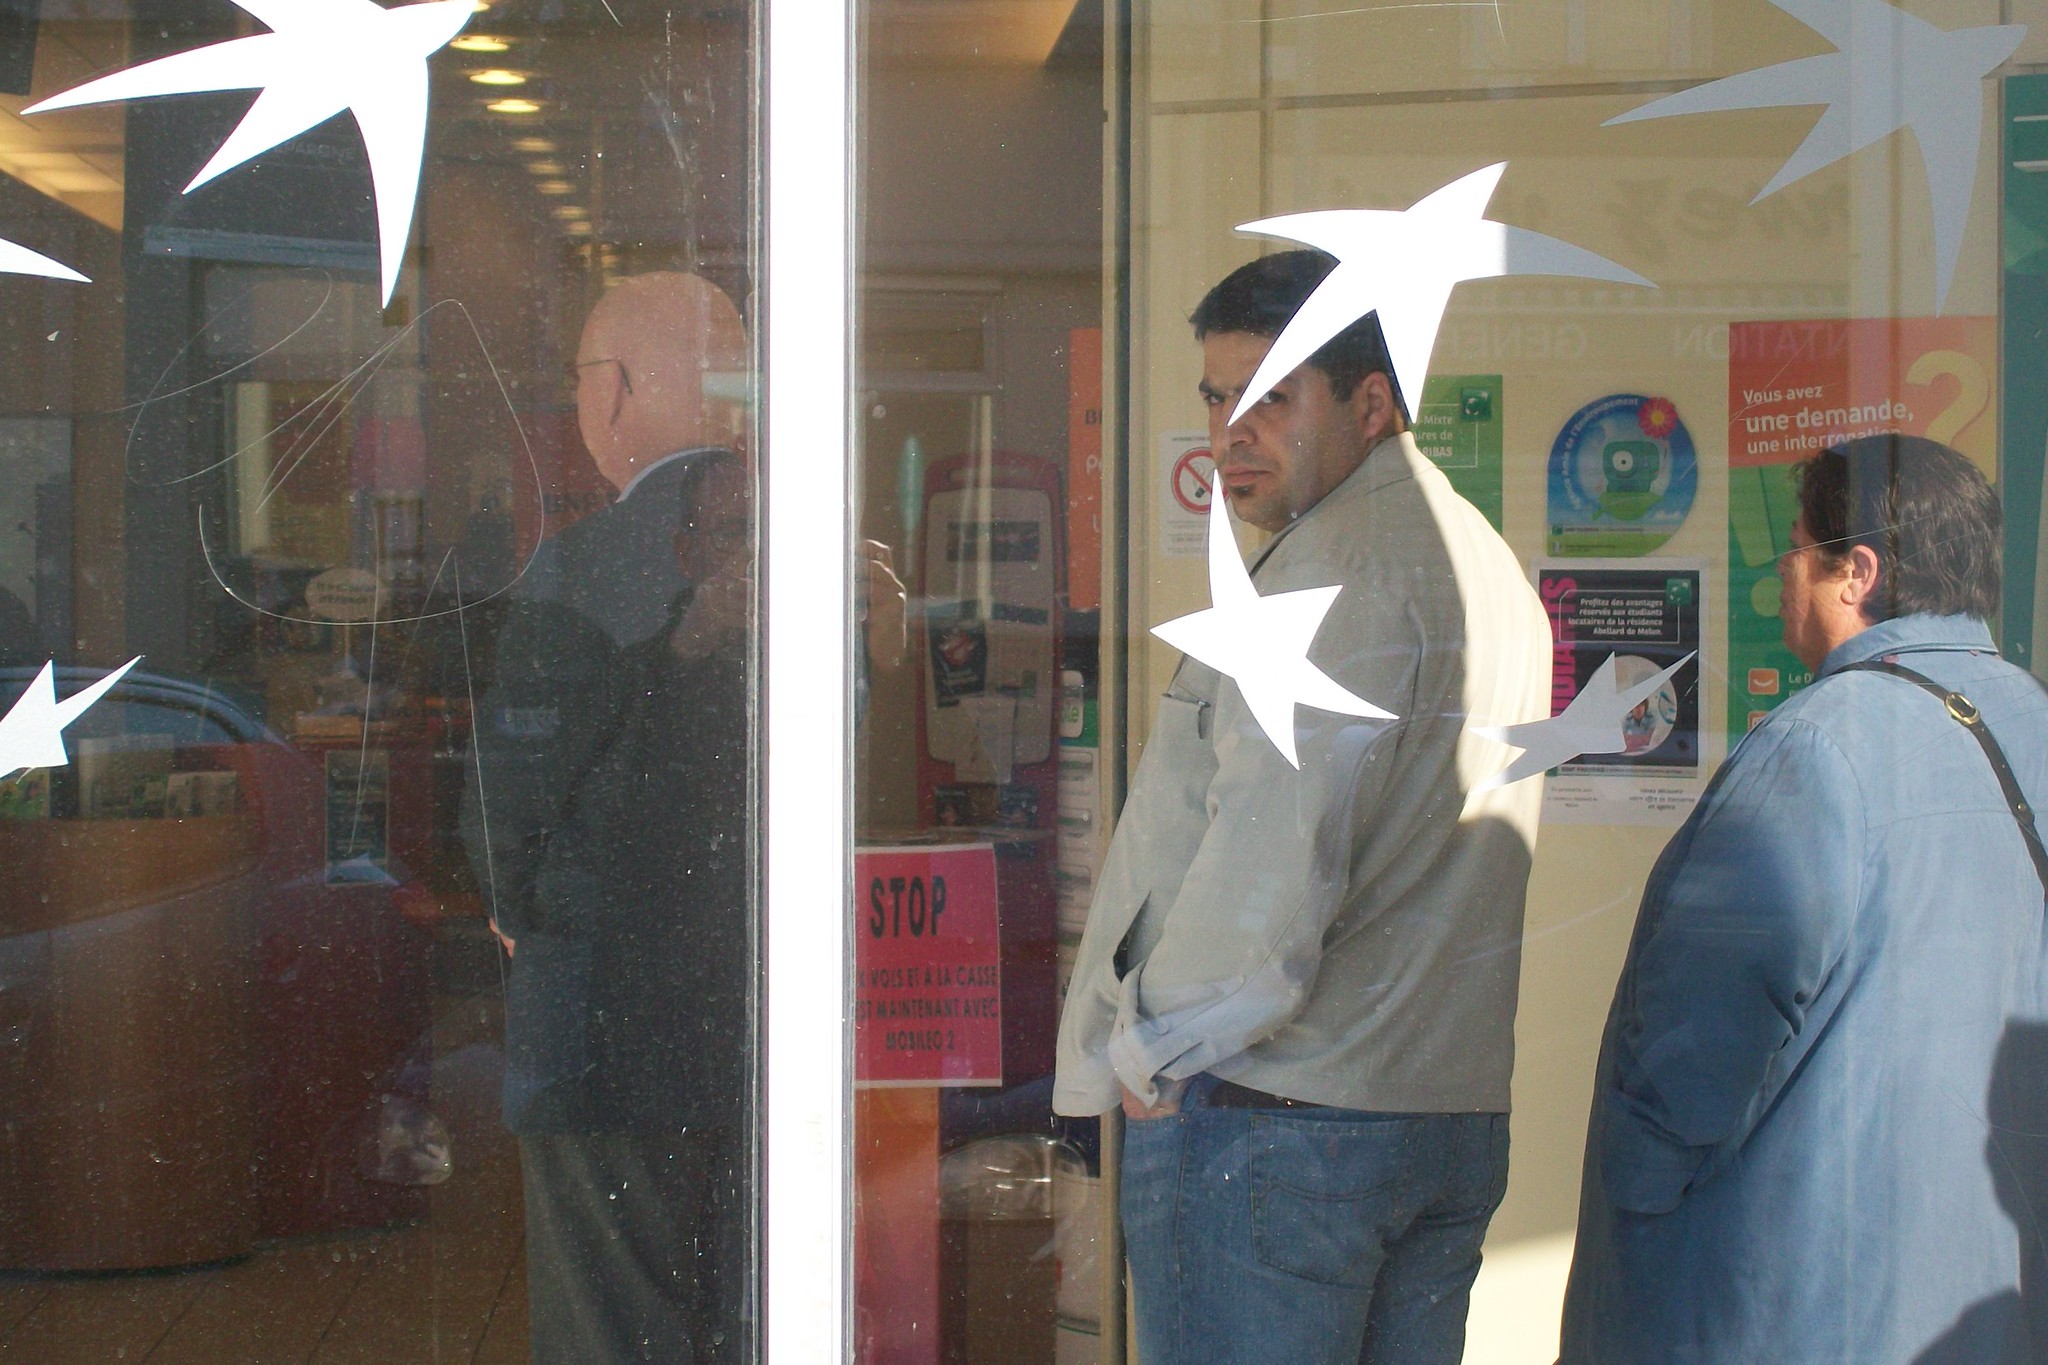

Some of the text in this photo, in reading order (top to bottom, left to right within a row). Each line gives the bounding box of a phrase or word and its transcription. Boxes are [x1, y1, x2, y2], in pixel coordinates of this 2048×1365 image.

[1743, 386, 1823, 405] Vous avez
[1746, 399, 1914, 433] une demande,
[1747, 440, 1780, 455] une
[1580, 598, 1663, 608] Profitez des avantages
[1579, 608, 1610, 616] réservés
[1627, 608, 1663, 616] étudiants
[1568, 617, 1663, 625] locataires de la résidence
[1626, 627, 1636, 635] de
[1788, 673, 1801, 683] Le
[869, 875, 946, 939] STOP
[871, 968, 903, 989] VOLS
[907, 967, 920, 988] ET
[924, 967, 932, 987] A
[938, 967, 951, 987] LA
[956, 965, 997, 987] CASSE
[877, 998, 959, 1018] MAINTENANT
[963, 998, 998, 1018] AVEC
